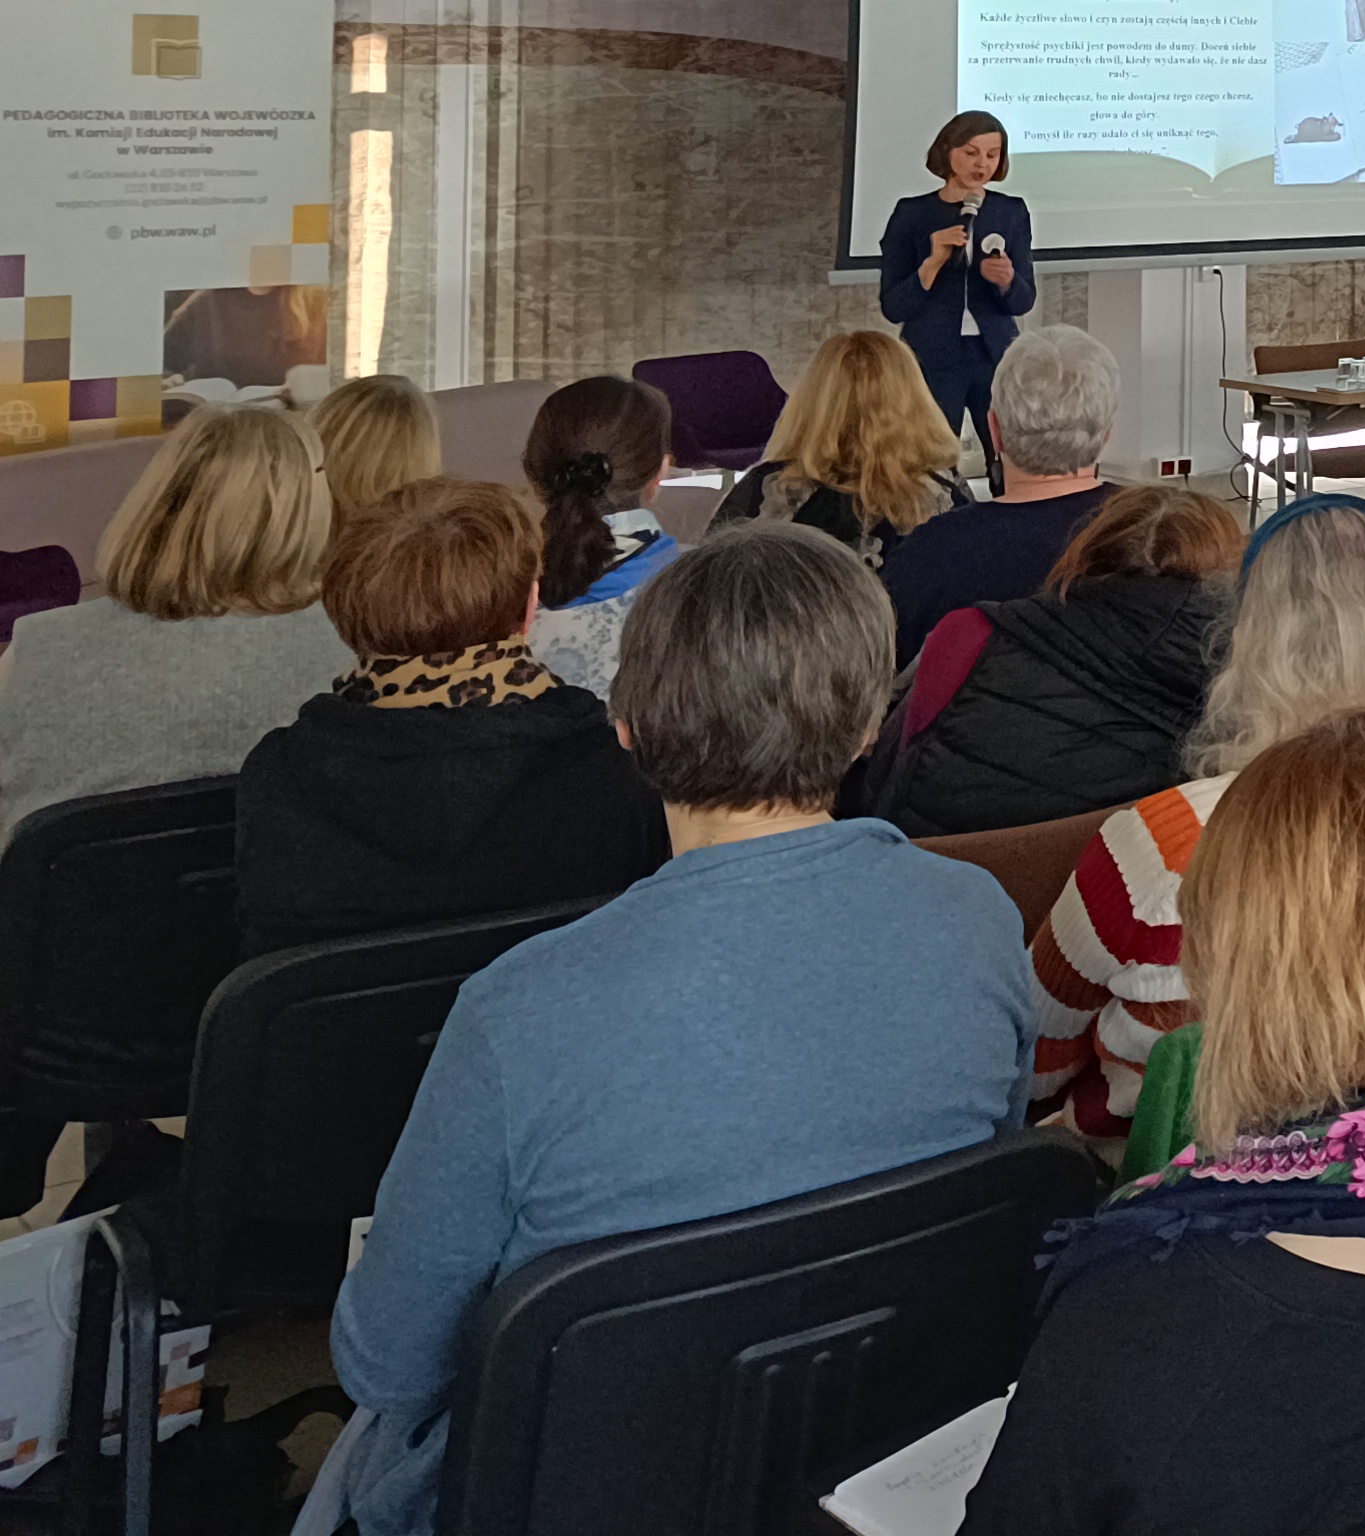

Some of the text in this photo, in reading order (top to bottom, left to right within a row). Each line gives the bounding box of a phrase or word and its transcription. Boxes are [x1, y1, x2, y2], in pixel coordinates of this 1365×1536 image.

[980, 13, 1012, 23] Każde
[1015, 13, 1057, 25] życzliwe
[1120, 15, 1153, 26] zostają
[1190, 15, 1221, 27] innych
[1043, 41, 1084, 52] psychiki
[1086, 41, 1104, 52] jest
[1107, 41, 1152, 52] powodem
[1155, 42, 1166, 51] do
[1231, 42, 1257, 51] siebie
[982, 55, 1044, 66] przetrwanie
[1046, 55, 1091, 66] trudnych
[1125, 56, 1151, 67] kiedy
[1232, 56, 1246, 64] nie
[1248, 55, 1268, 64] dasz
[984, 93, 1014, 104] Kiedy
[1017, 93, 1030, 104] się
[1096, 92, 1108, 101] bo
[1111, 92, 1125, 101] nie
[1128, 92, 1171, 103] dostajesz
[1173, 92, 1192, 102] tego
[1195, 93, 1220, 102] czego
[3, 108, 316, 121] PEDAGOGICZNA BIBLIOTEKA WOJEWÓDZKA
[1121, 110, 1132, 118] do
[47, 127, 72, 138] im.
[136, 126, 197, 141] Edukacji
[201, 126, 278, 141] Narodowej
[1063, 130, 1075, 139] ile
[1077, 132, 1099, 141] razy
[1142, 129, 1153, 140] się
[116, 144, 213, 155] w Warszawie
[130, 223, 216, 240] pbw.waw.pl
